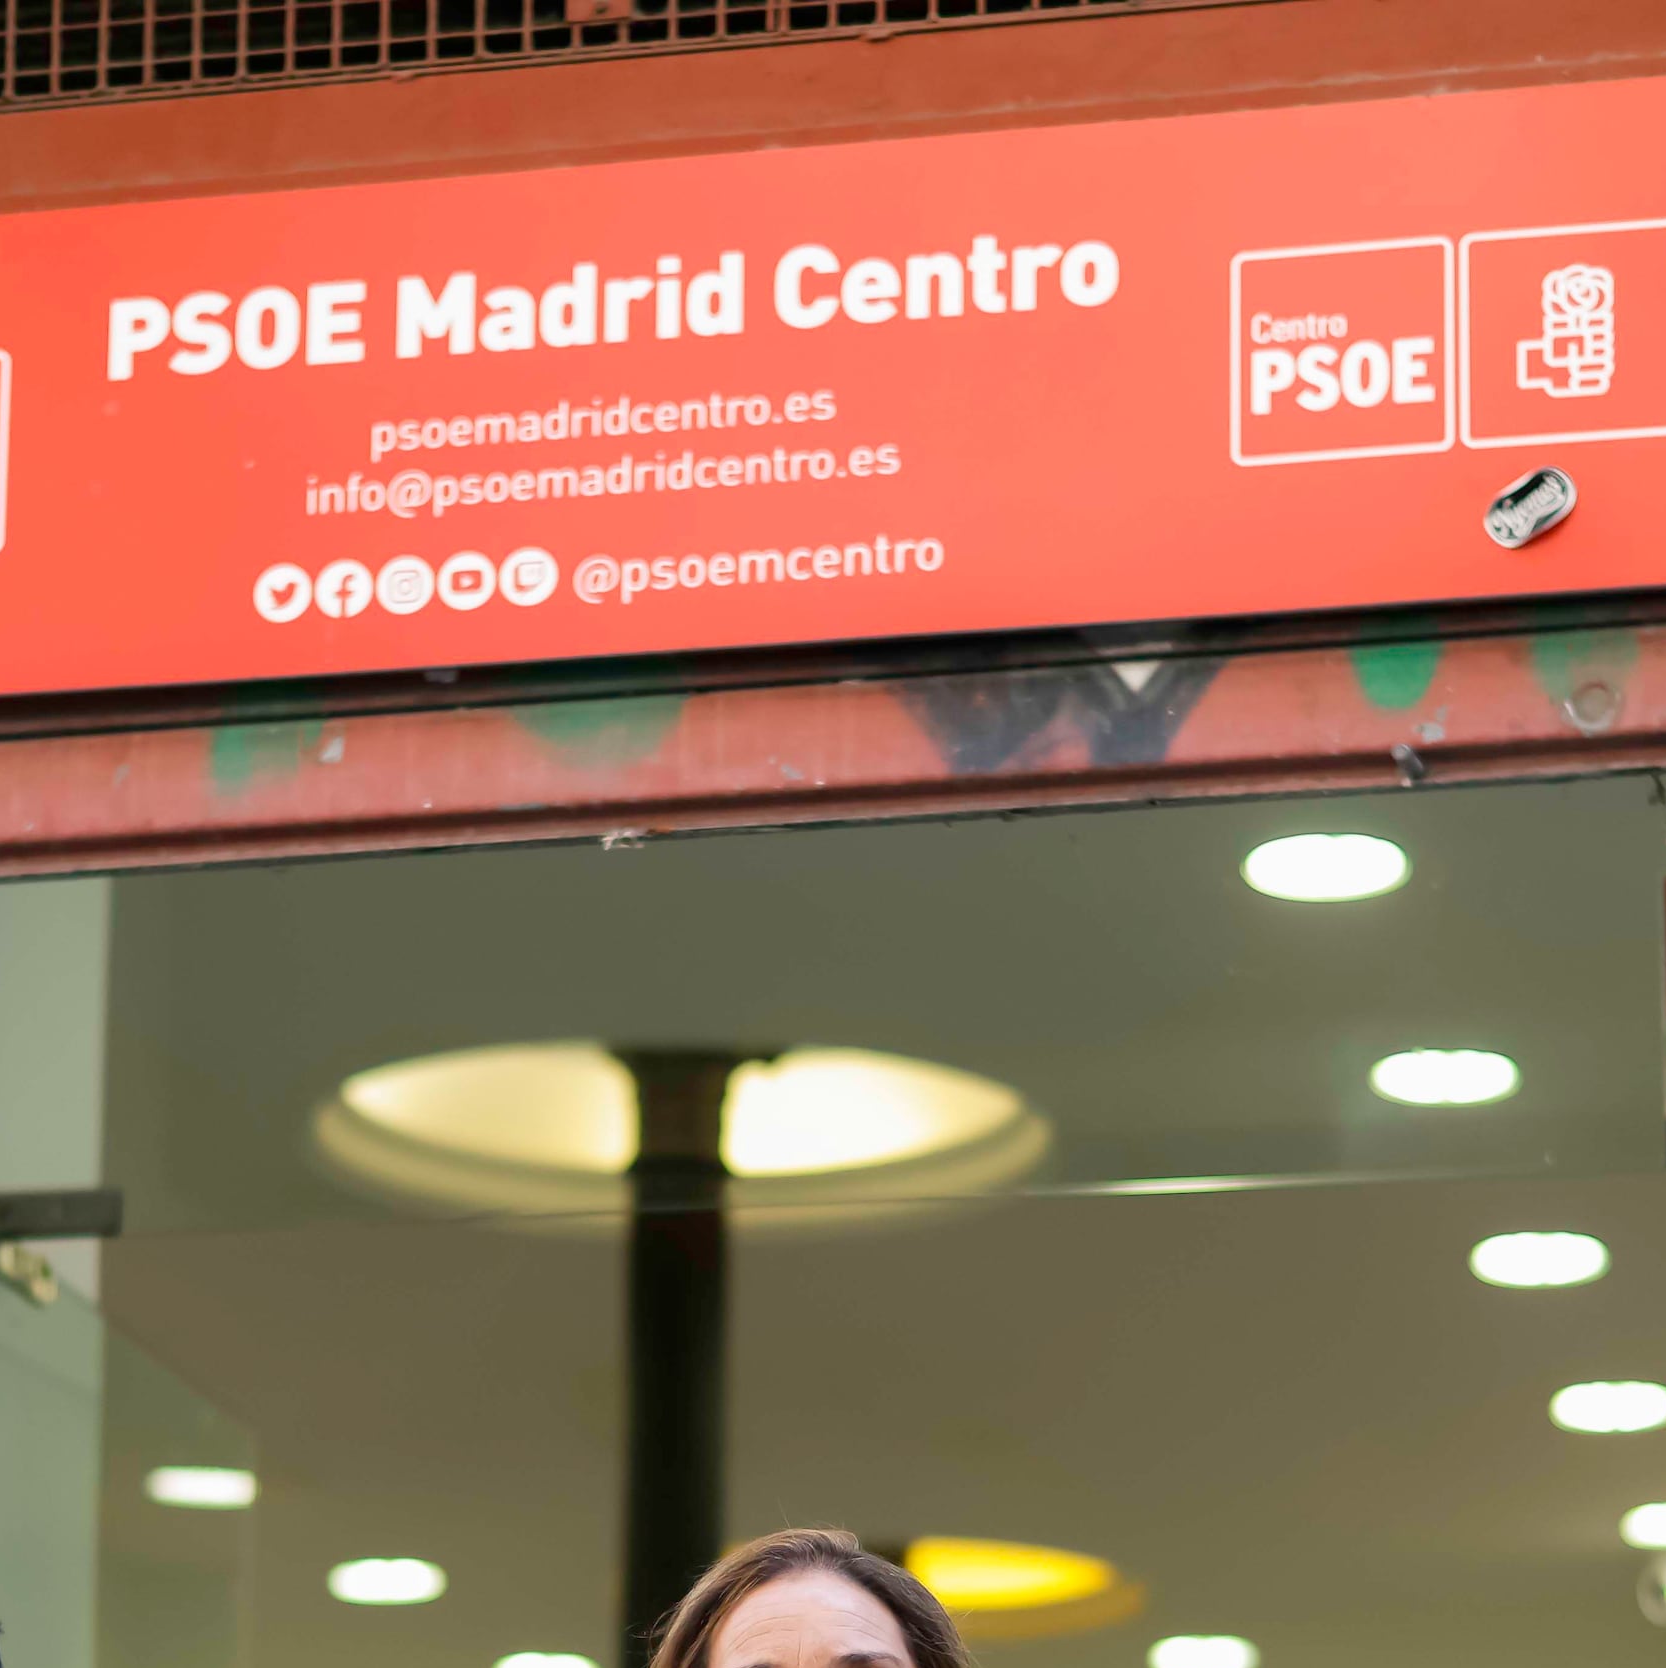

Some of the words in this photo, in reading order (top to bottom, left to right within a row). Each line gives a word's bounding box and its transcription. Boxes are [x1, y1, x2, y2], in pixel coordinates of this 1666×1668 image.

[106, 279, 368, 382] PSOE
[394, 250, 746, 360] Madrid
[773, 234, 1121, 331] Centro
[1250, 311, 1349, 343] Centro
[1251, 336, 1437, 416] PSOE
[369, 388, 838, 463] psoemadridcentro.es
[305, 440, 902, 519] info@psoemadridcentro.es
[571, 533, 946, 606] @psoemcentro
